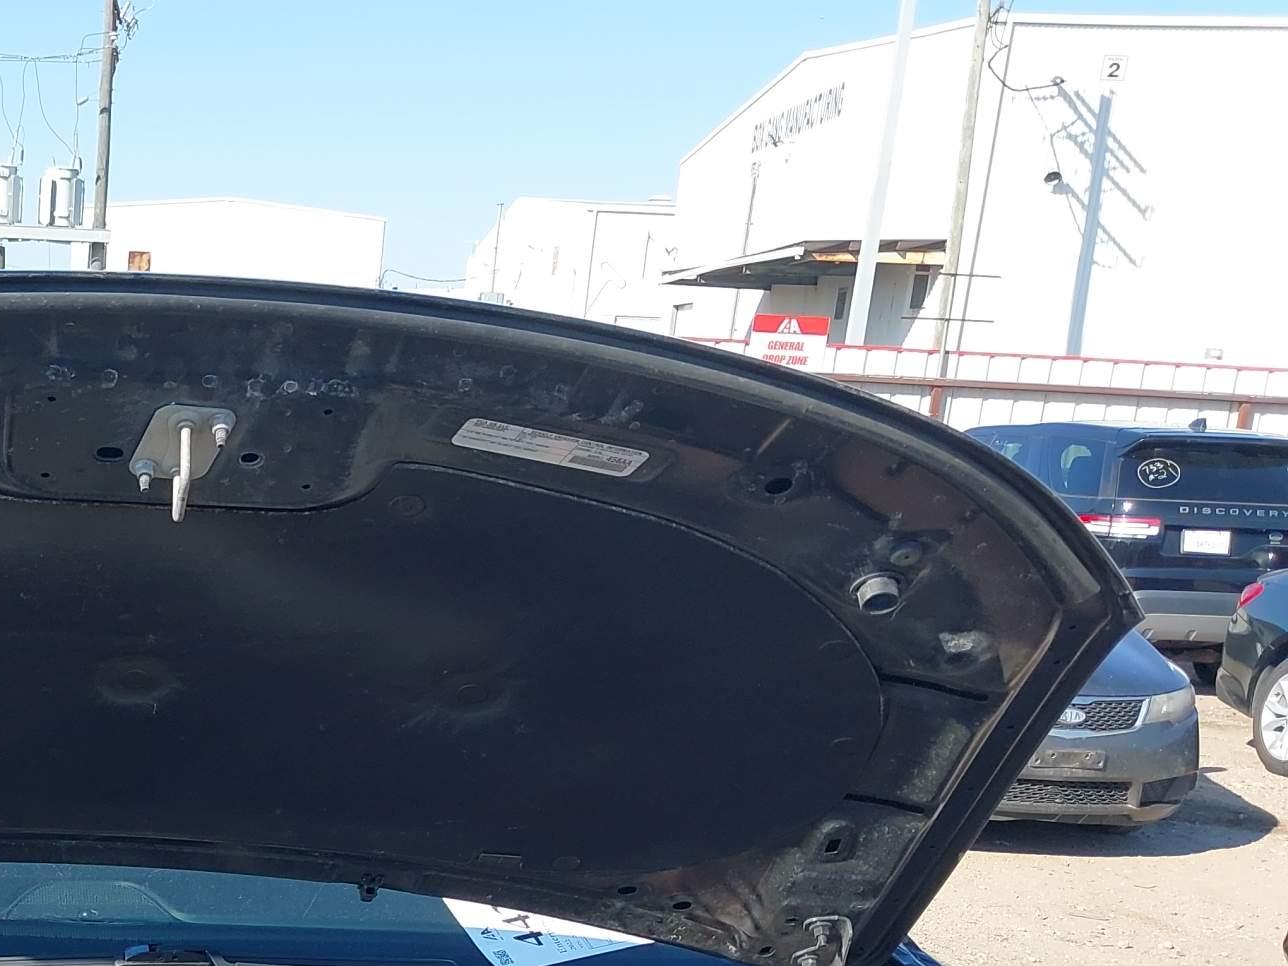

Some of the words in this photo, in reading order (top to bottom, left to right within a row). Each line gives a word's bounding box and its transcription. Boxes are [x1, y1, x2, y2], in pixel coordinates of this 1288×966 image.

[1107, 62, 1121, 78] 2
[767, 340, 806, 352] GENERAL
[785, 355, 809, 367] ZONE
[1179, 505, 1288, 519] DISCOVERY
